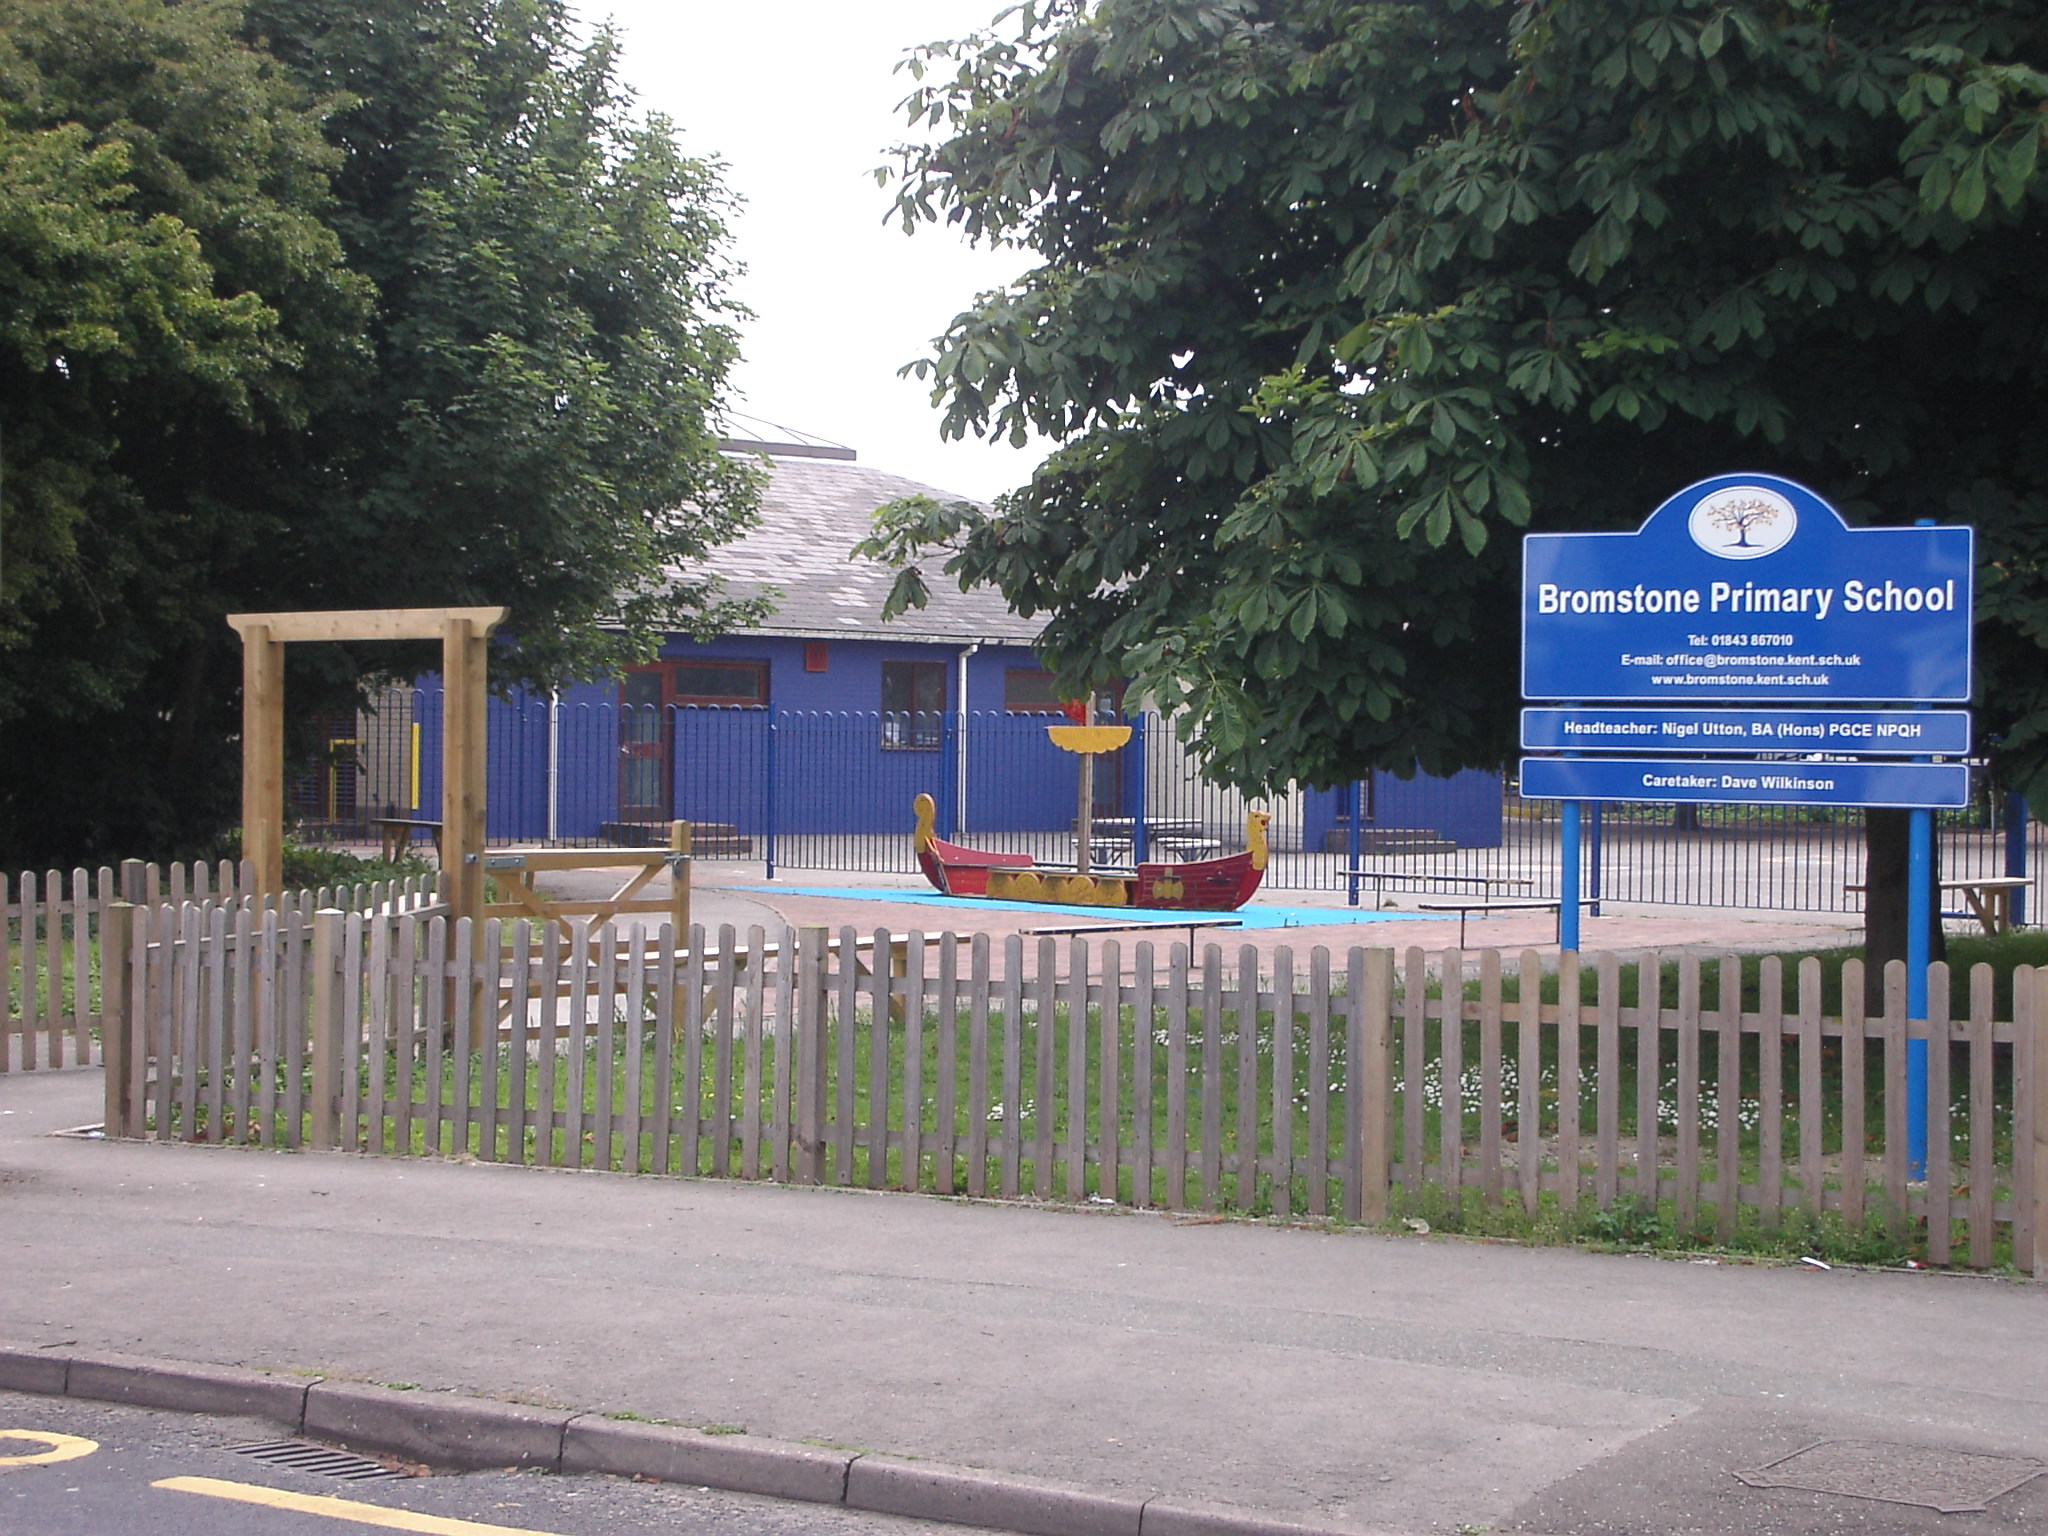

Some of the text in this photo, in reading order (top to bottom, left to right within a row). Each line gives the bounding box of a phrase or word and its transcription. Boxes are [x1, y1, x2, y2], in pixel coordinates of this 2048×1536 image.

[1538, 579, 1955, 620] Bromstone Primary School
[1687, 634, 1793, 647] Tel: 01843 867010
[1621, 653, 1861, 668] E-mail: office@bromstone.kent.sch.uk
[1651, 672, 1830, 686] www.bromstone.kent.sch.uk
[1564, 721, 1922, 739] Headteacher: Nigel Utton, BA (Hons) PGCE NPQH
[1642, 774, 1835, 791] Caretaker: Dave Wilkinson
